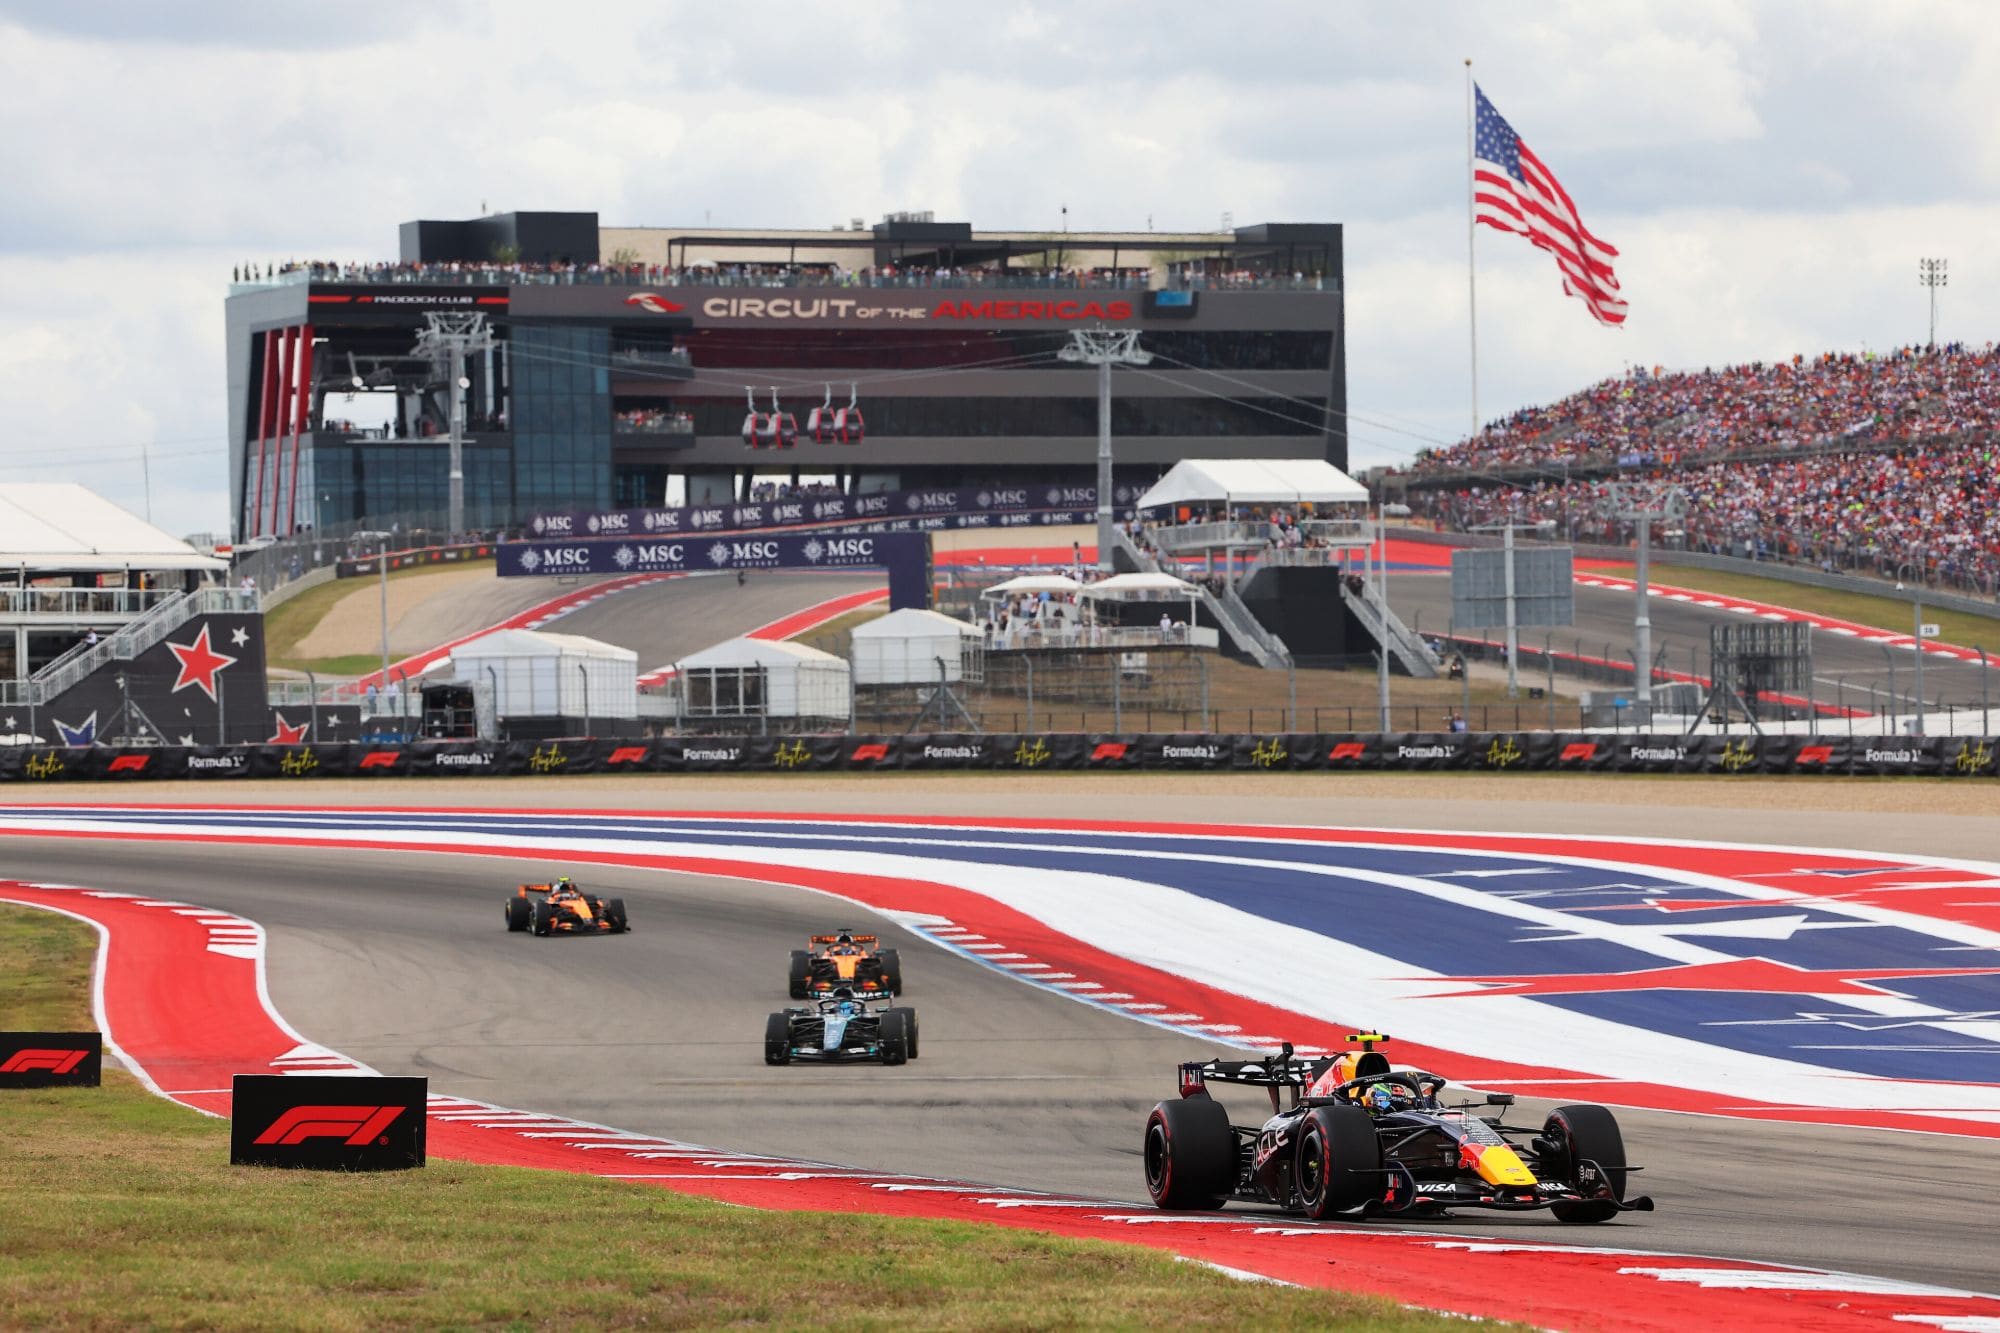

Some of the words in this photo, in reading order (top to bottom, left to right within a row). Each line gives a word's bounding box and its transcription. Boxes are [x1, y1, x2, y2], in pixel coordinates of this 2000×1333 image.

[374, 295, 437, 303] PADDOCK
[703, 298, 856, 318] CIRCUIT
[856, 308, 883, 317] OF
[887, 308, 926, 318] THE
[932, 300, 1133, 320] AMERICAS
[924, 493, 956, 506] MSC
[994, 490, 1026, 504] MSC
[1063, 488, 1096, 501] MSC
[546, 516, 572, 530] MSC
[601, 514, 628, 529] MSC
[655, 512, 678, 526] MSC
[638, 545, 683, 562] MSC
[733, 542, 778, 559] MSC
[827, 539, 873, 556] MSC
[544, 548, 589, 566] MSC
[683, 748, 728, 761] Formula
[924, 746, 971, 759] Formula
[1163, 745, 1207, 758] Formula
[1399, 746, 1444, 758] Formula
[1631, 747, 1676, 761] Formula
[1866, 749, 1911, 762] Formula
[188, 757, 232, 769] Formula
[436, 753, 482, 766] Formula
[0, 1049, 89, 1074] F1
[253, 1106, 407, 1145] F1
[1416, 1183, 1457, 1193] VISA
